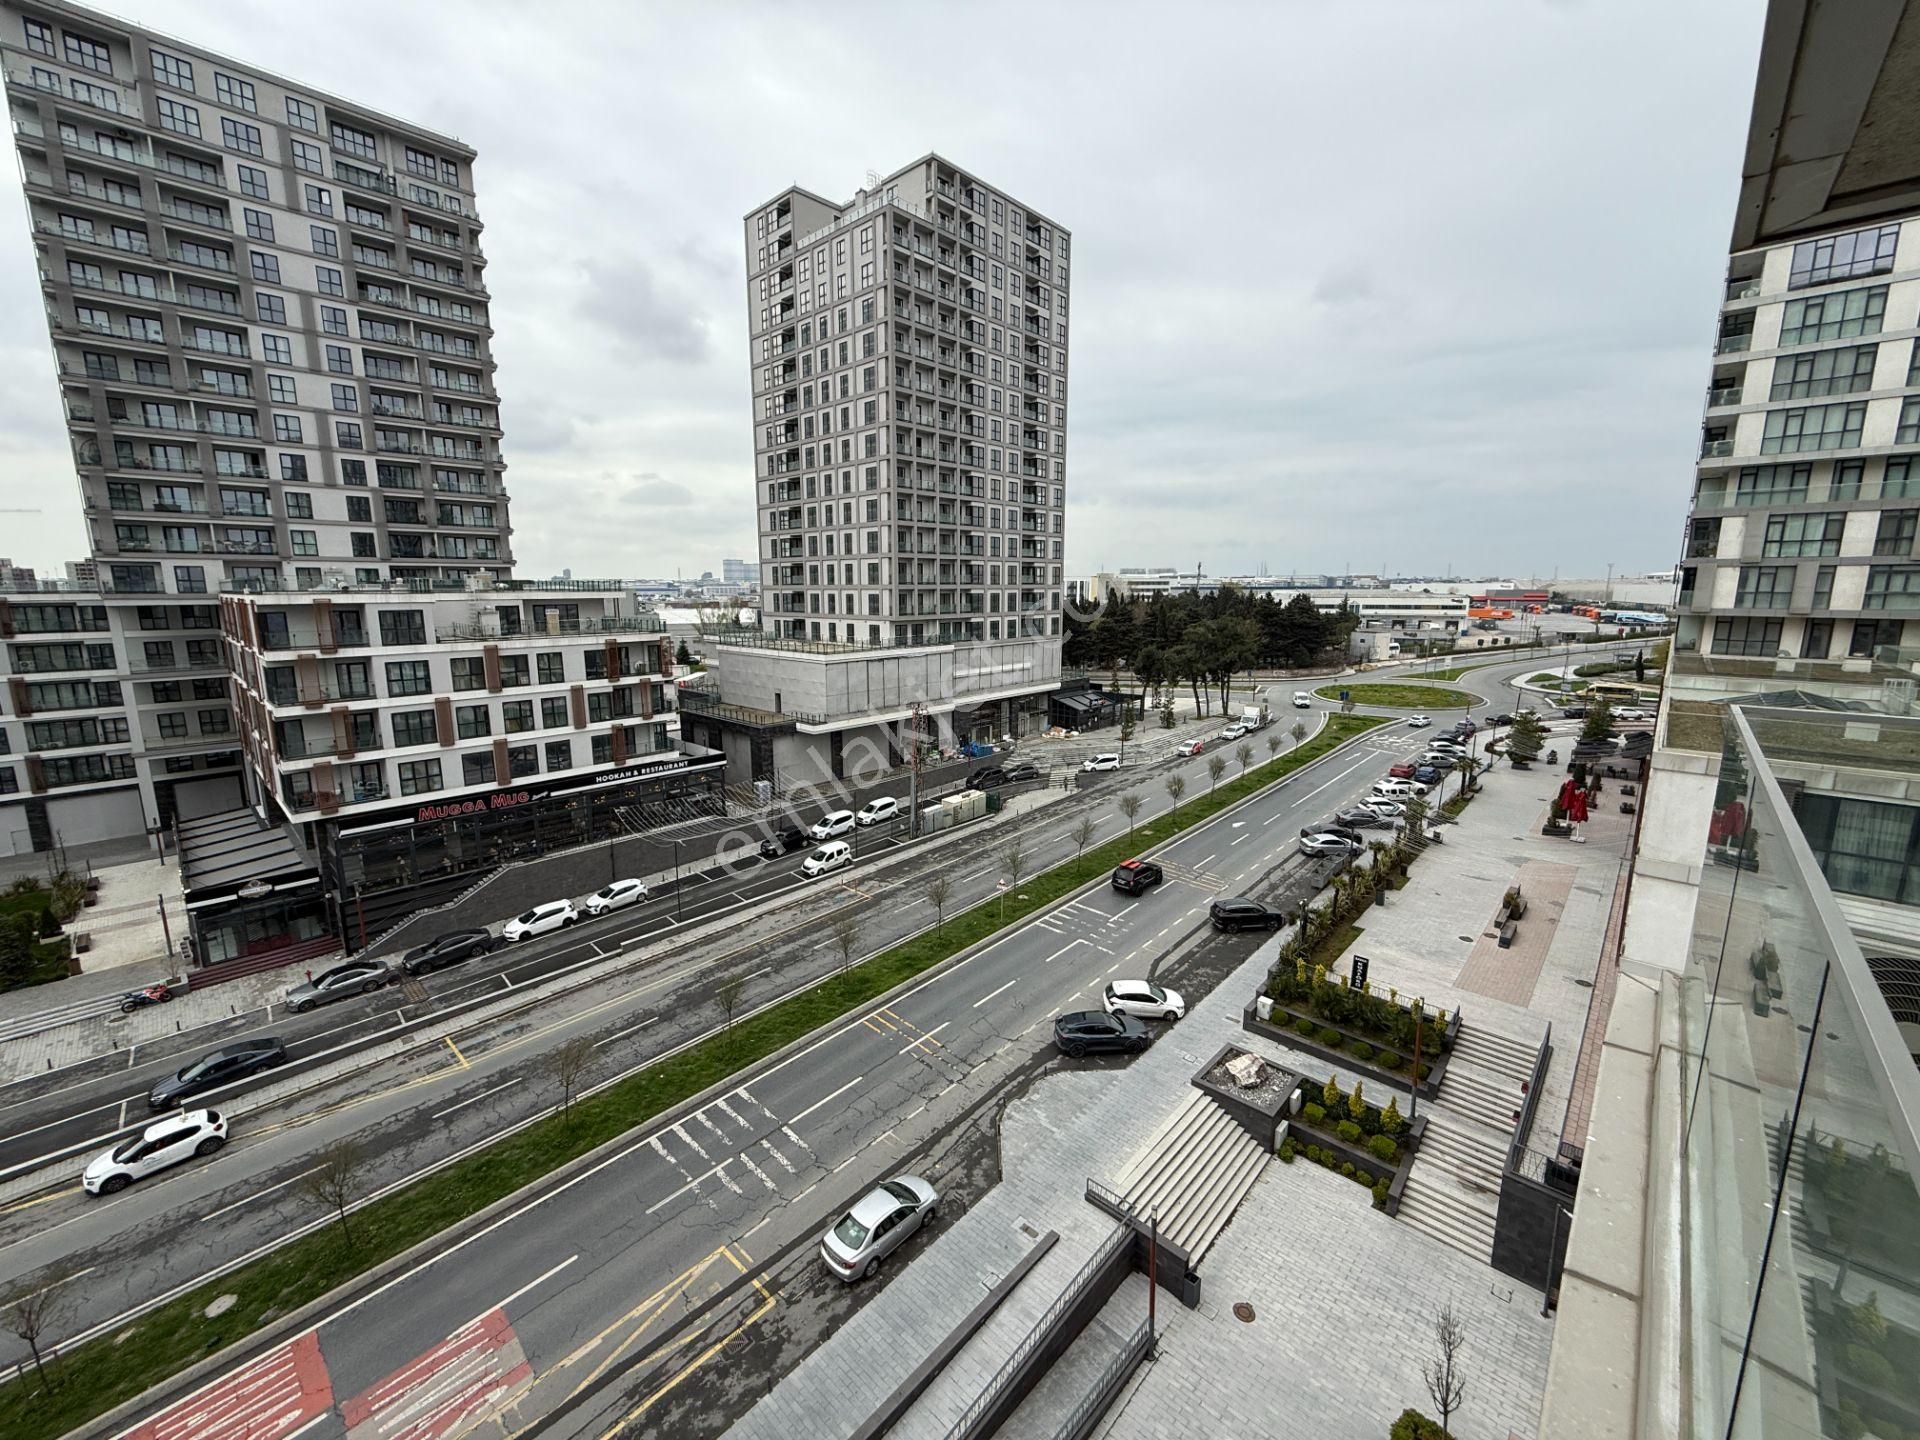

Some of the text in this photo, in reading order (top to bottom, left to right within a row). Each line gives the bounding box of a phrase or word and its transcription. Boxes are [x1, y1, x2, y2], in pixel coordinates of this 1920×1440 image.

[596, 770, 632, 783] HOOKAH
[641, 761, 689, 775] RESTAURANT
[419, 800, 486, 821] MUGGA
[491, 791, 529, 808] MUG
